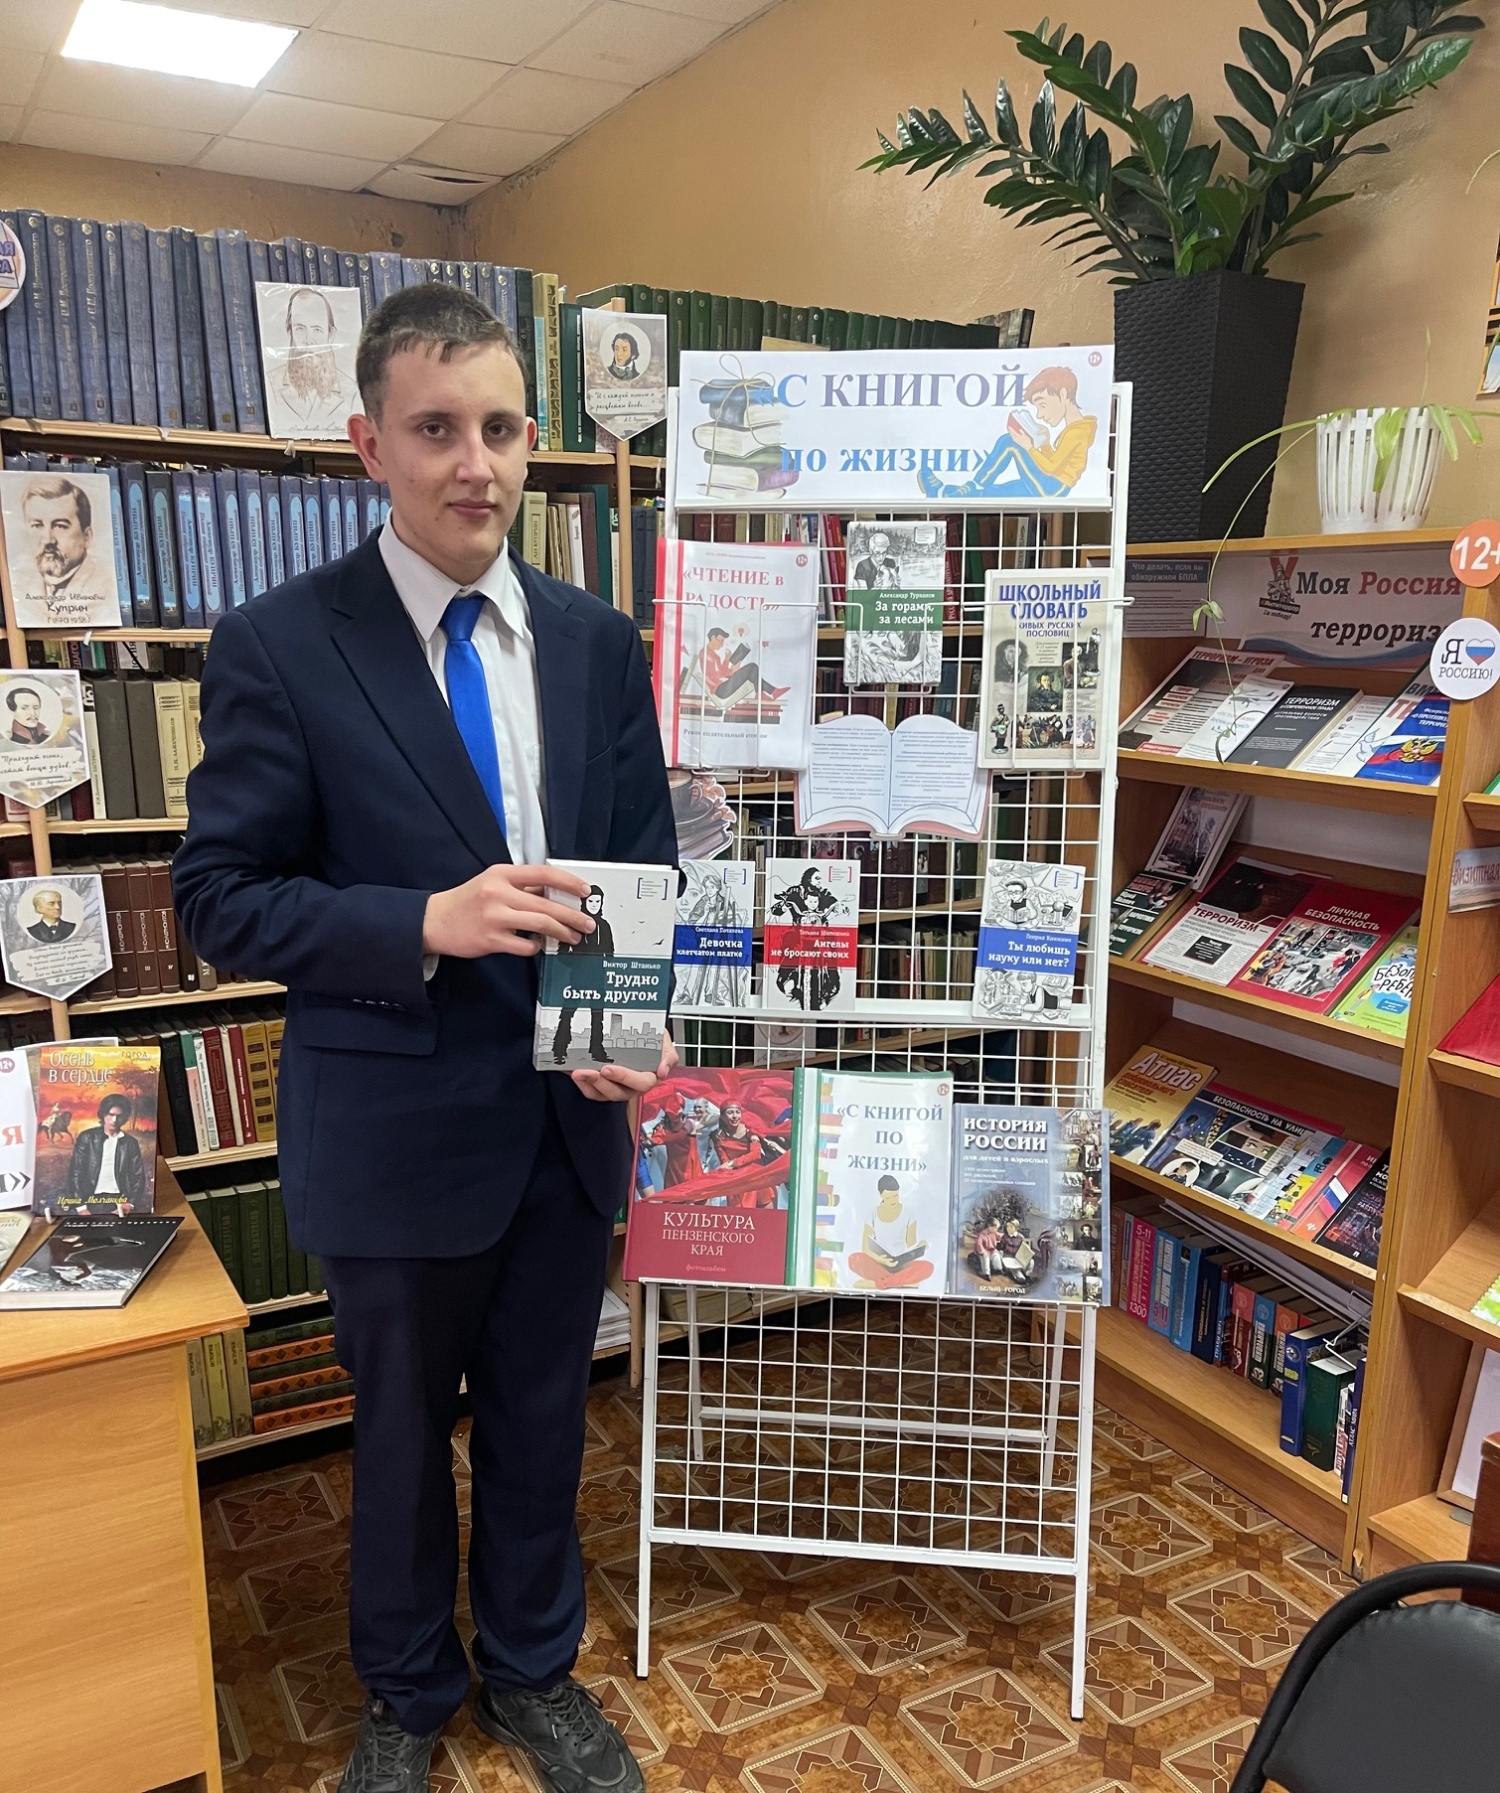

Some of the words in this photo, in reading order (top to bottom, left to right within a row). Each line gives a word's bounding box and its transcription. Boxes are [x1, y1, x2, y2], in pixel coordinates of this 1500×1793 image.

[755, 374, 808, 408] «С
[820, 364, 1029, 408] КНИГОЙ
[1132, 562, 1145, 570] Что
[1146, 563, 1173, 571] делать,
[683, 566, 770, 586] «ЧТЕНИЕ
[1131, 573, 1177, 582] обнаружили
[1178, 573, 1198, 581] БПЛА
[1296, 572, 1350, 595] Моя
[1359, 571, 1462, 595] Россия
[998, 579, 1102, 602] ШКОЛЬНЫЙ
[47, 601, 88, 615] Куприн
[875, 600, 888, 611] За
[879, 616, 891, 624] за
[1026, 630, 1070, 638] ПОСЛОВИЦ
[1310, 620, 1447, 647] террориз
[1441, 638, 1464, 665] Я
[1438, 666, 1493, 680] РОССИЮ!
[1284, 697, 1341, 706] ТЕРРОРИЗМ
[1193, 907, 1259, 932] ТЕРРОРИЗМ
[1304, 908, 1380, 931] БЕЗОПАСНОСТЬ
[1327, 905, 1371, 920] ЛИЧНАЯ
[699, 937, 743, 950] Девочка
[813, 939, 849, 950] Ангелы
[1008, 941, 1024, 951] Ты
[1026, 943, 1071, 955] любишь
[717, 951, 743, 959] платке
[784, 949, 820, 959] бросают
[822, 951, 849, 959] своих
[988, 953, 1020, 965] науку
[1022, 956, 1042, 965] или
[1044, 957, 1070, 968] нет?
[603, 960, 628, 969] Виктор
[631, 962, 661, 970] Штанько
[606, 971, 660, 987] Трудно
[562, 986, 601, 1000] быть
[604, 990, 659, 1003] другом
[49, 1050, 95, 1067] Осень
[48, 1069, 57, 1083] в
[61, 1069, 113, 1087] сердце
[1129, 1052, 1203, 1091] Атлас
[836, 1104, 859, 1118] «С
[864, 1103, 943, 1121] КНИГОЙ
[1213, 1095, 1270, 1122] БЕЗОПАСНОСТЬ
[1271, 1117, 1284, 1127] НА
[964, 1118, 1047, 1133] ИСТОРИЯ
[874, 1130, 903, 1144] ПО
[964, 1134, 1047, 1151] РОССИИ
[847, 1154, 927, 1172] ЖИЗНИ»
[57, 1196, 82, 1208] Ирина
[86, 1193, 128, 1204] Молчанова
[663, 1211, 755, 1230] КУЛЬТУРА
[662, 1228, 755, 1245] ПЕНЗЕНСКОГО
[691, 1244, 723, 1256] КРАЯ
[685, 1263, 726, 1273] фотоальбом
[1129, 1301, 1147, 1318] 1300
